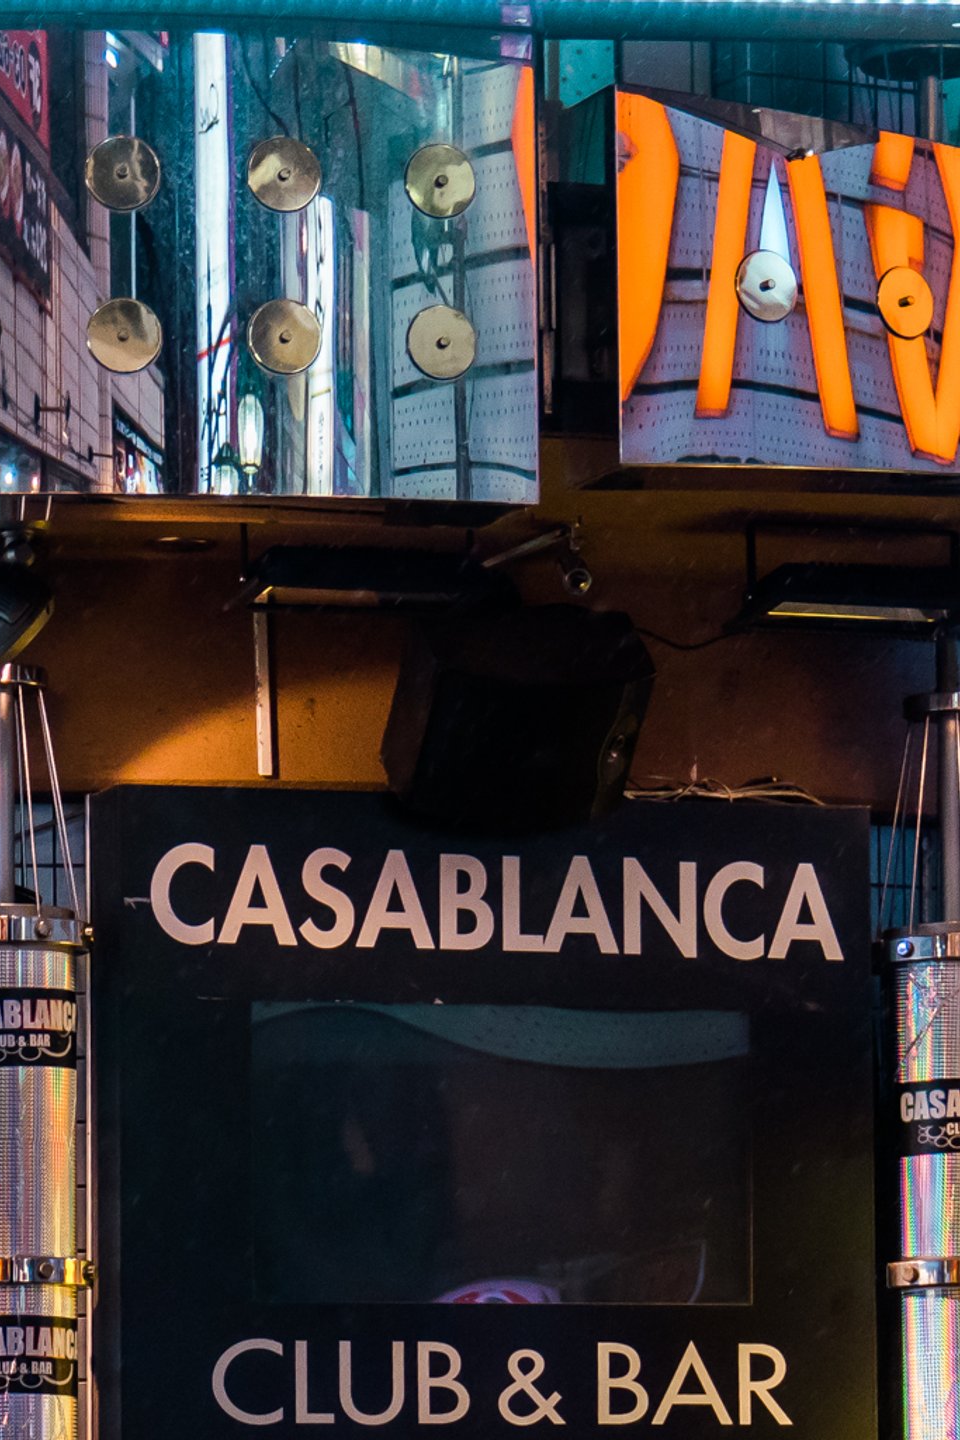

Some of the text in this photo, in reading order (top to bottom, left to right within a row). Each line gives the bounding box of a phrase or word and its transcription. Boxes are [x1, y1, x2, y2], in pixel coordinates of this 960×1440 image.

[150, 842, 845, 962] CASABLANCA
[18, 1035, 27, 1047] &
[29, 1034, 51, 1047] BAR
[19, 1361, 28, 1374] &
[31, 1361, 53, 1375] BAR
[211, 1337, 793, 1427] CLUB & BAR
